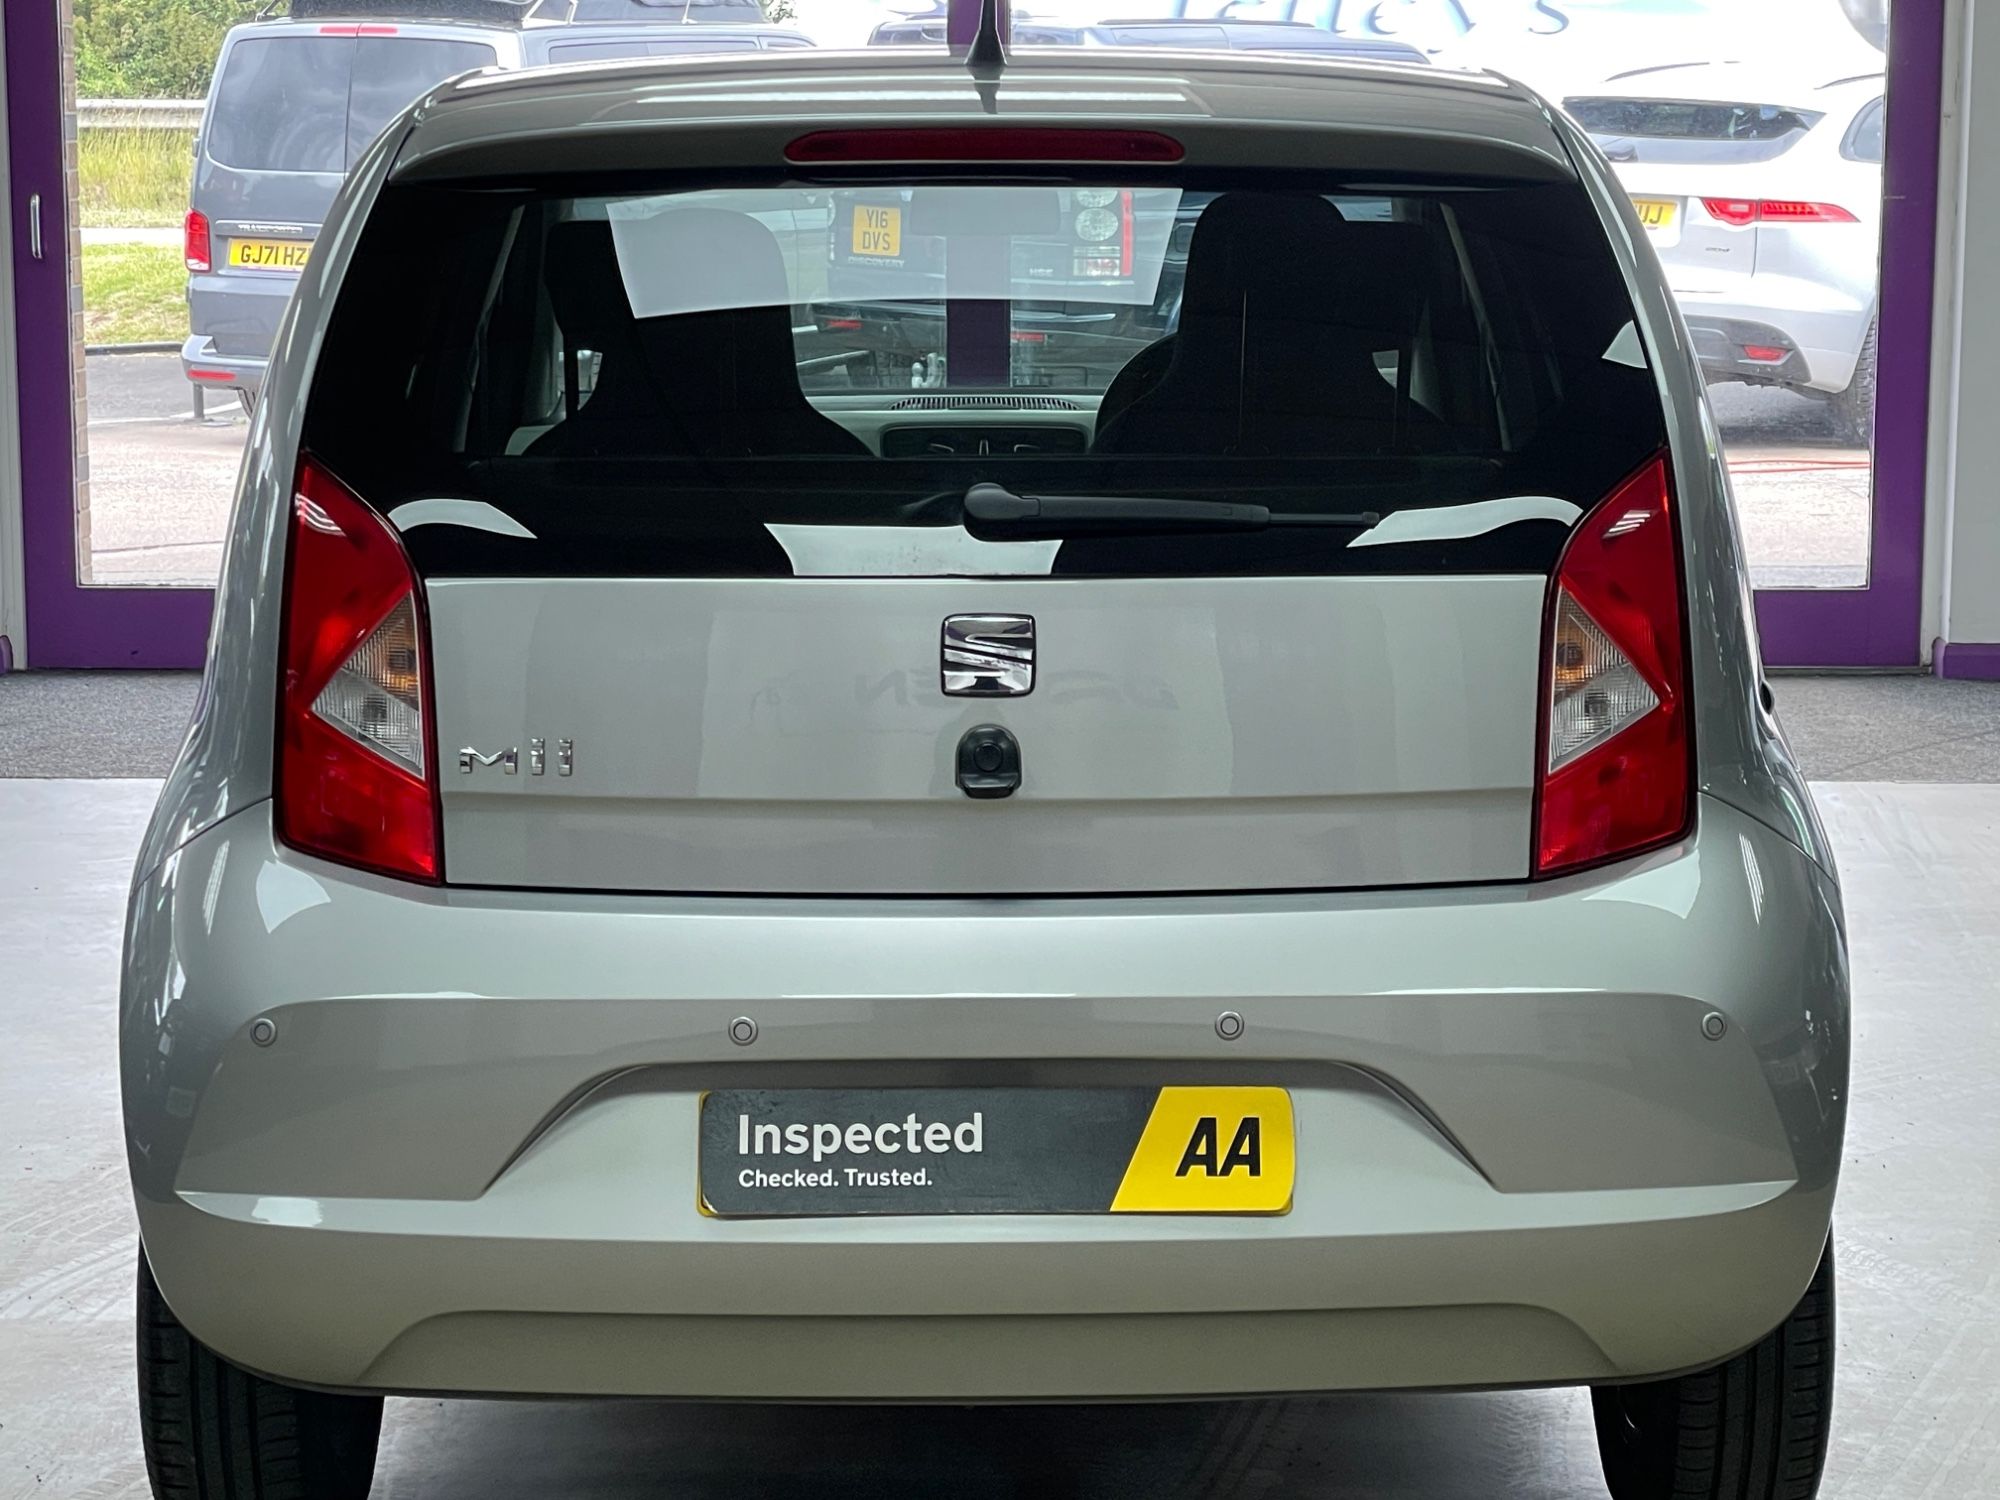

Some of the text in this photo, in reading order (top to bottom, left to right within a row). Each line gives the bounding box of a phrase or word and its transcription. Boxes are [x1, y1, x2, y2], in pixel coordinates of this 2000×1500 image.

[866, 208, 889, 229] Y16
[862, 231, 890, 252] DVS
[240, 244, 313, 266] GJ71 HZ
[847, 256, 905, 269] DISCOVERY
[738, 1112, 1261, 1177] Inspected AA
[738, 1167, 933, 1188] Checked. Trusted.
